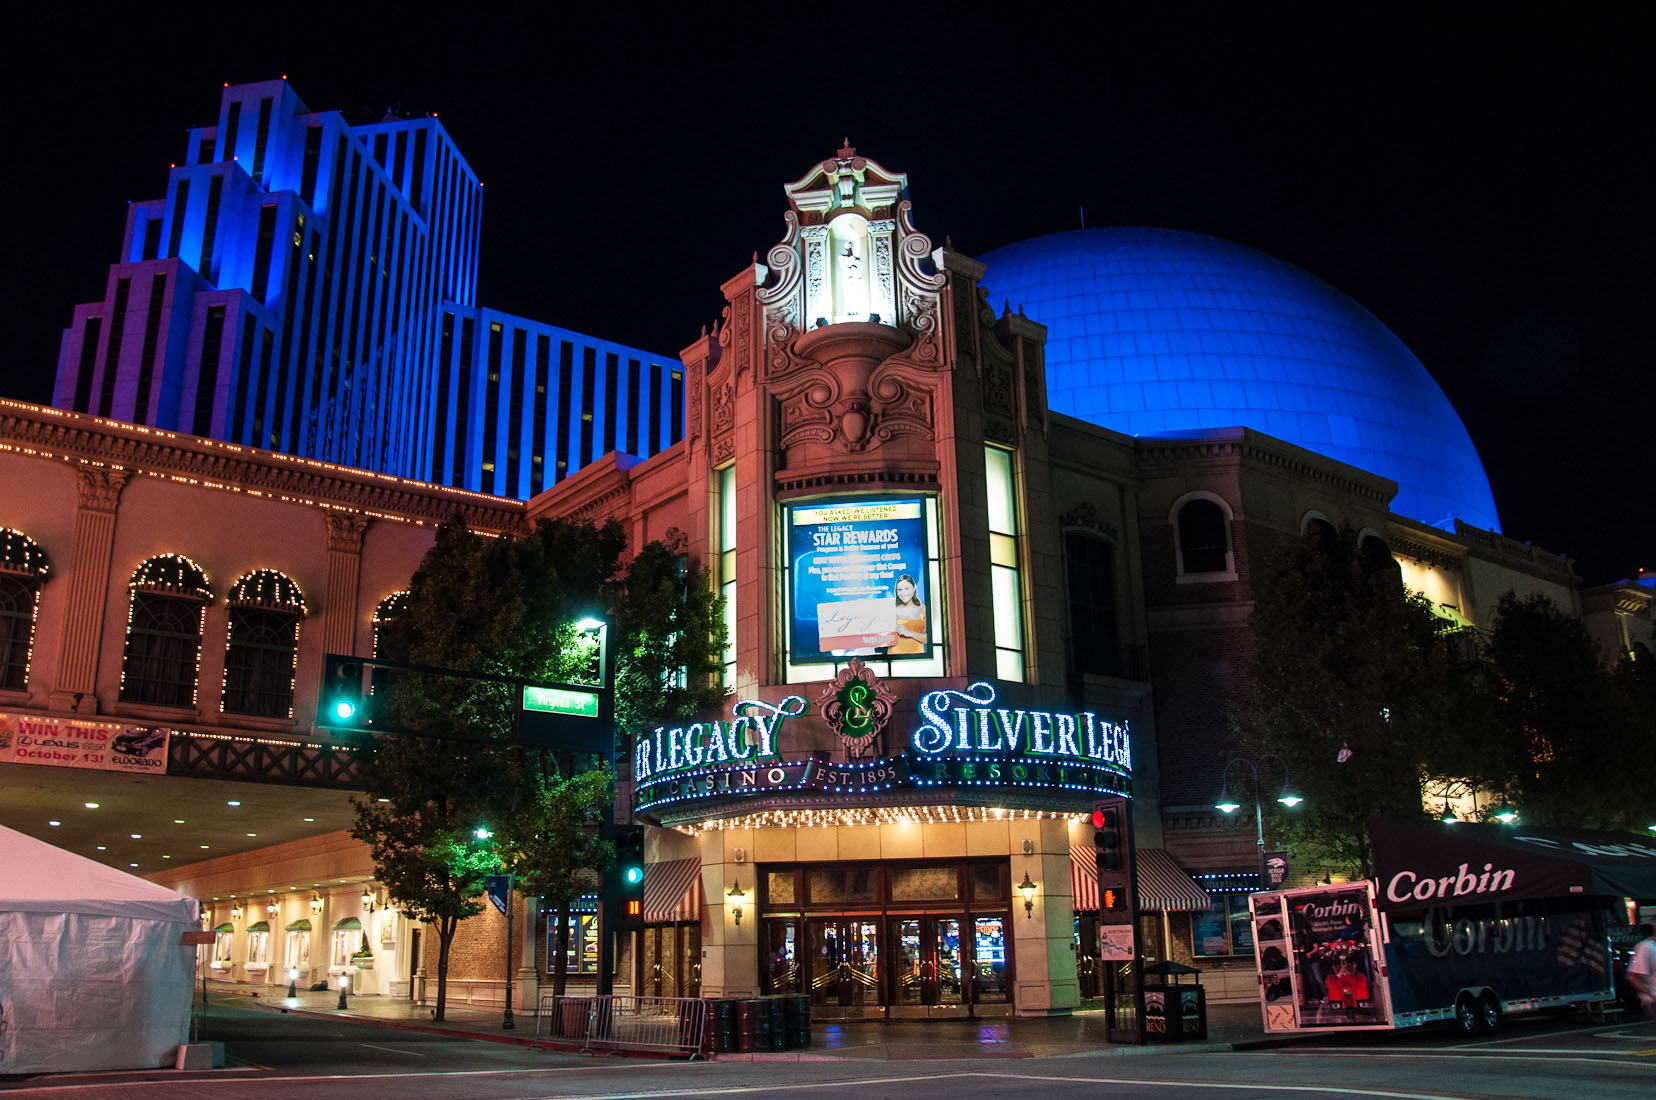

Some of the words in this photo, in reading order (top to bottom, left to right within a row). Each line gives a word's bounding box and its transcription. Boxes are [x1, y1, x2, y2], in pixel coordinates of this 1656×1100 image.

[866, 506, 897, 514] LISTENED
[813, 532, 841, 546] STAR
[843, 529, 898, 545] REWARDS
[824, 609, 876, 633] Legy
[536, 694, 570, 710] Virginia
[914, 682, 1080, 755] SILVER
[18, 722, 58, 736] WIN
[65, 726, 108, 741] THIS
[654, 695, 809, 772] LEGACY
[34, 740, 80, 748] LEXUS
[16, 748, 78, 761] October
[83, 754, 104, 764] 13!
[669, 767, 785, 795] CASINO
[816, 768, 854, 785] EST.
[860, 766, 896, 785] 1895
[934, 763, 1070, 783] RESORT
[1386, 862, 1516, 903] Corbin
[1303, 899, 1358, 918] Corbin
[1424, 902, 1546, 958] Corbin
[1146, 1022, 1166, 1033] RENO
